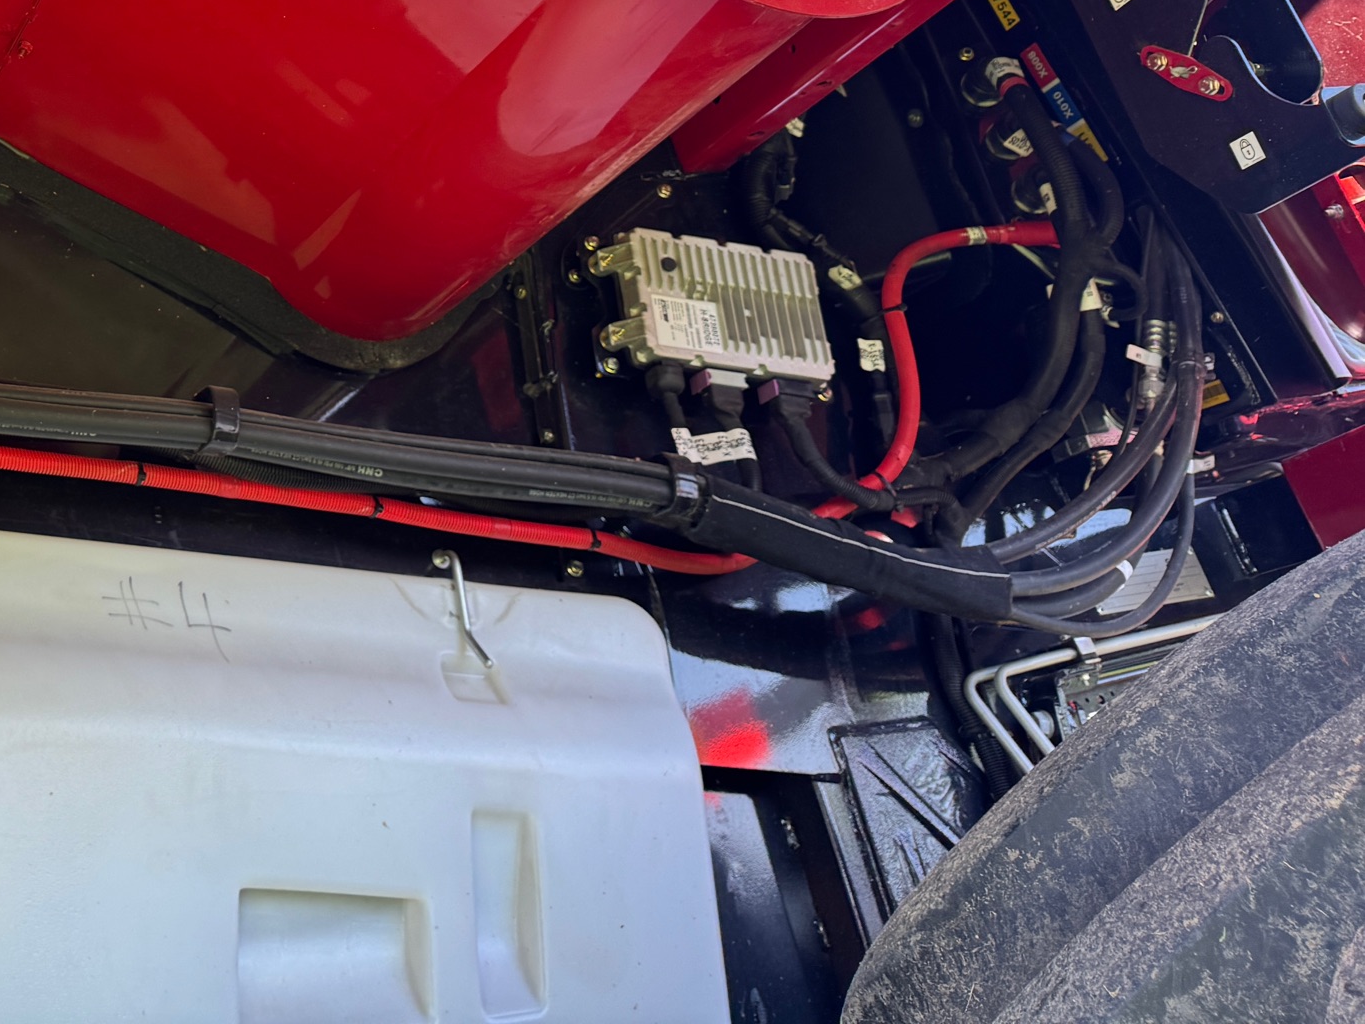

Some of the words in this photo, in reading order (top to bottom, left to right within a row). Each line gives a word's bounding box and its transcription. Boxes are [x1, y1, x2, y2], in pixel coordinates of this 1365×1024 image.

[1027, 50, 1049, 79] X008
[1052, 90, 1075, 119] X010
[357, 464, 384, 477] CNH
[627, 497, 653, 508] CNH
